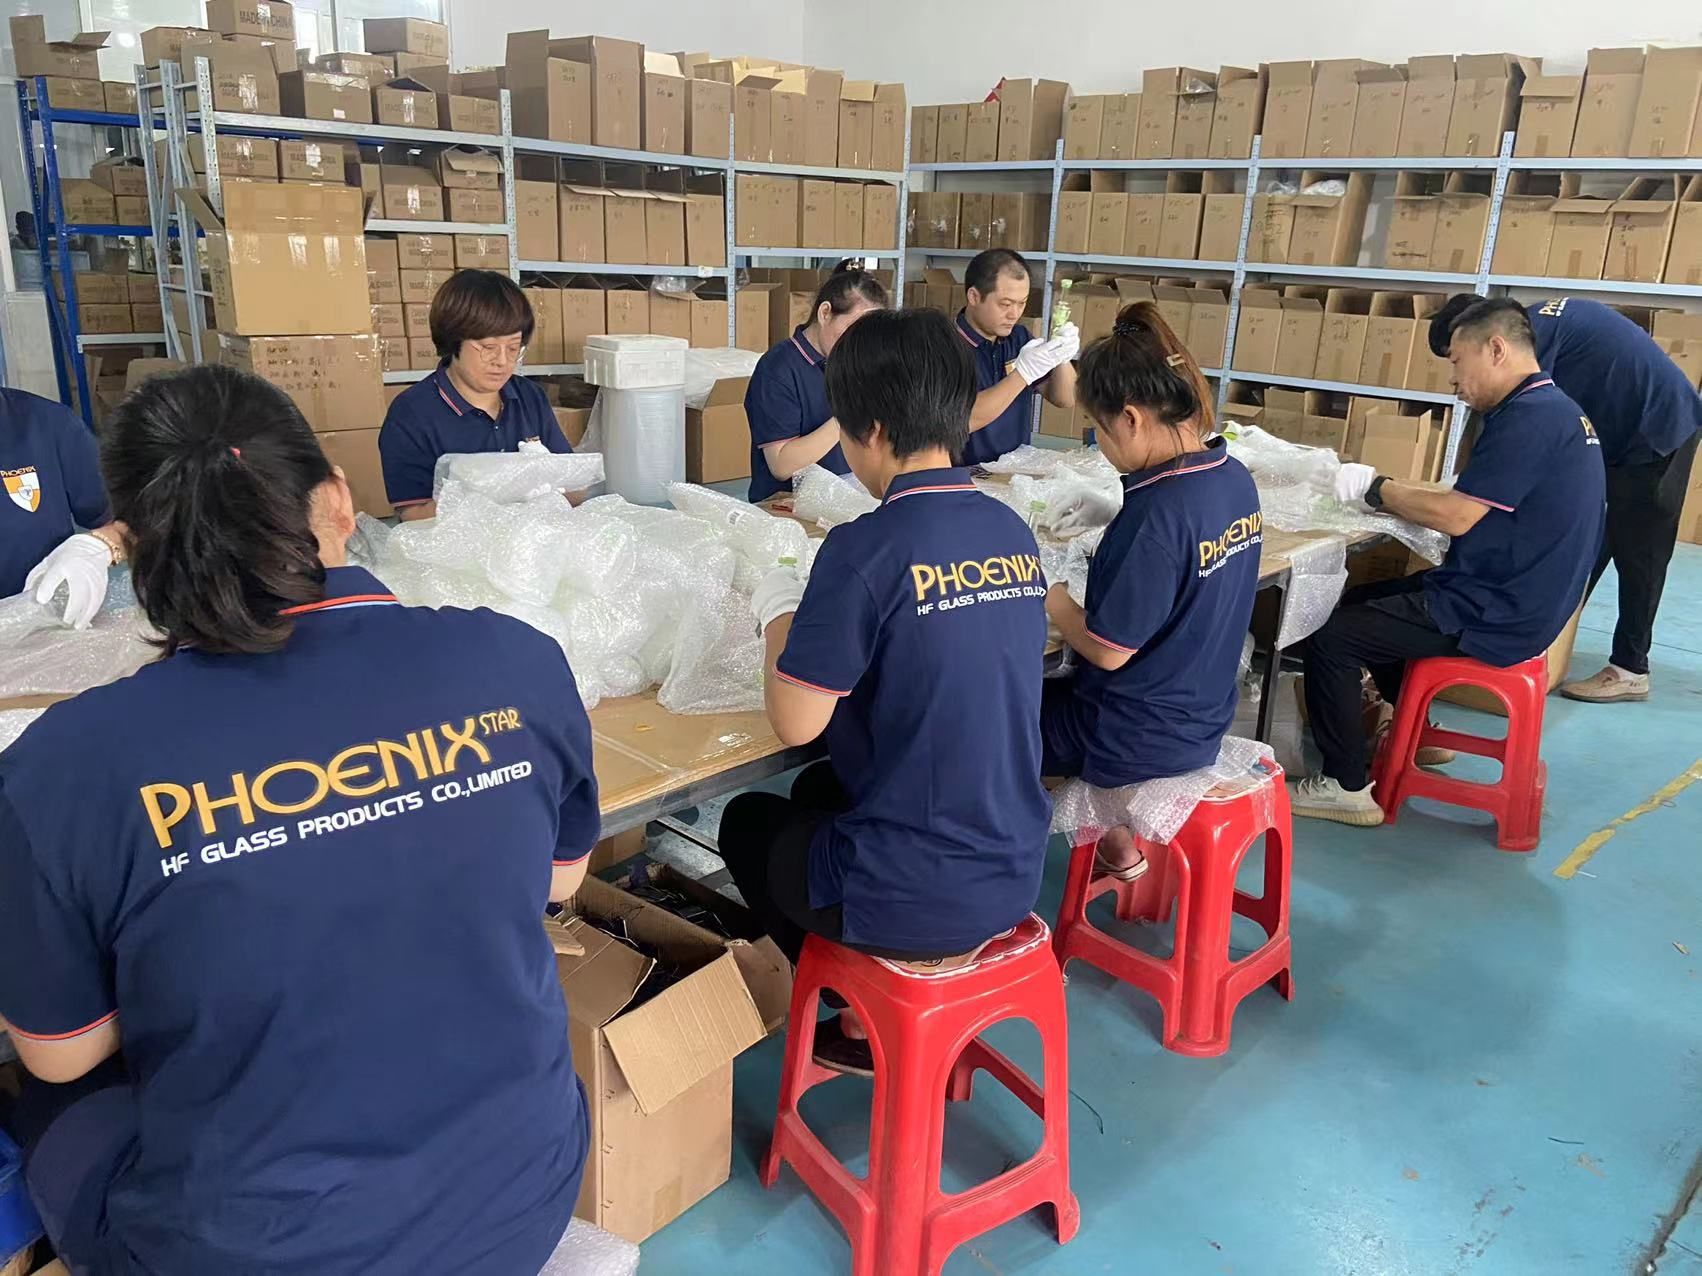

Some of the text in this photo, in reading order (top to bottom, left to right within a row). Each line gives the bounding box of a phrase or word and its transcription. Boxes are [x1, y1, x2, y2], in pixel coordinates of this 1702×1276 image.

[910, 554, 1040, 601] PHOENIX
[916, 603, 934, 616] HF
[938, 594, 975, 611] GLASS
[977, 587, 1022, 603] PRODUCTS
[140, 706, 522, 849] PHOENIX STAR
[160, 852, 191, 878] HF
[200, 826, 288, 865] GLASS
[297, 790, 424, 839] PRODUCTS
